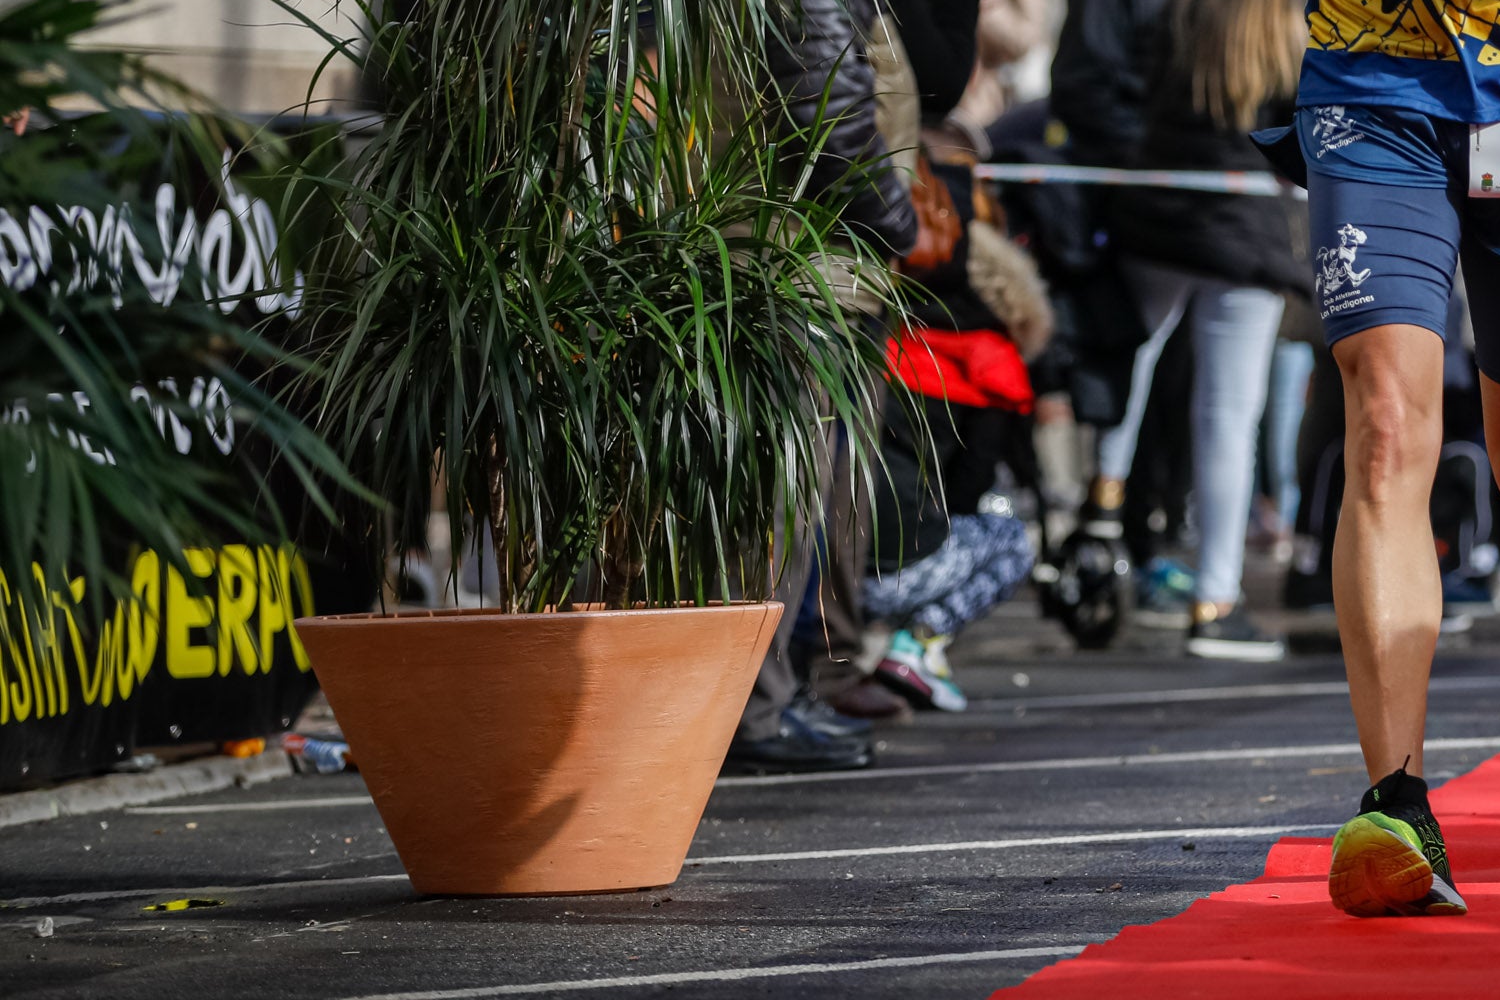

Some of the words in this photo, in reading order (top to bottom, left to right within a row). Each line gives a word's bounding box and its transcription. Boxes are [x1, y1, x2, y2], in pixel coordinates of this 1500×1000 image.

[1320, 310, 1330, 320] Los
[1329, 294, 1375, 315] Perdigones
[1324, 297, 1335, 307] Club
[1335, 289, 1361, 302] Atletismo
